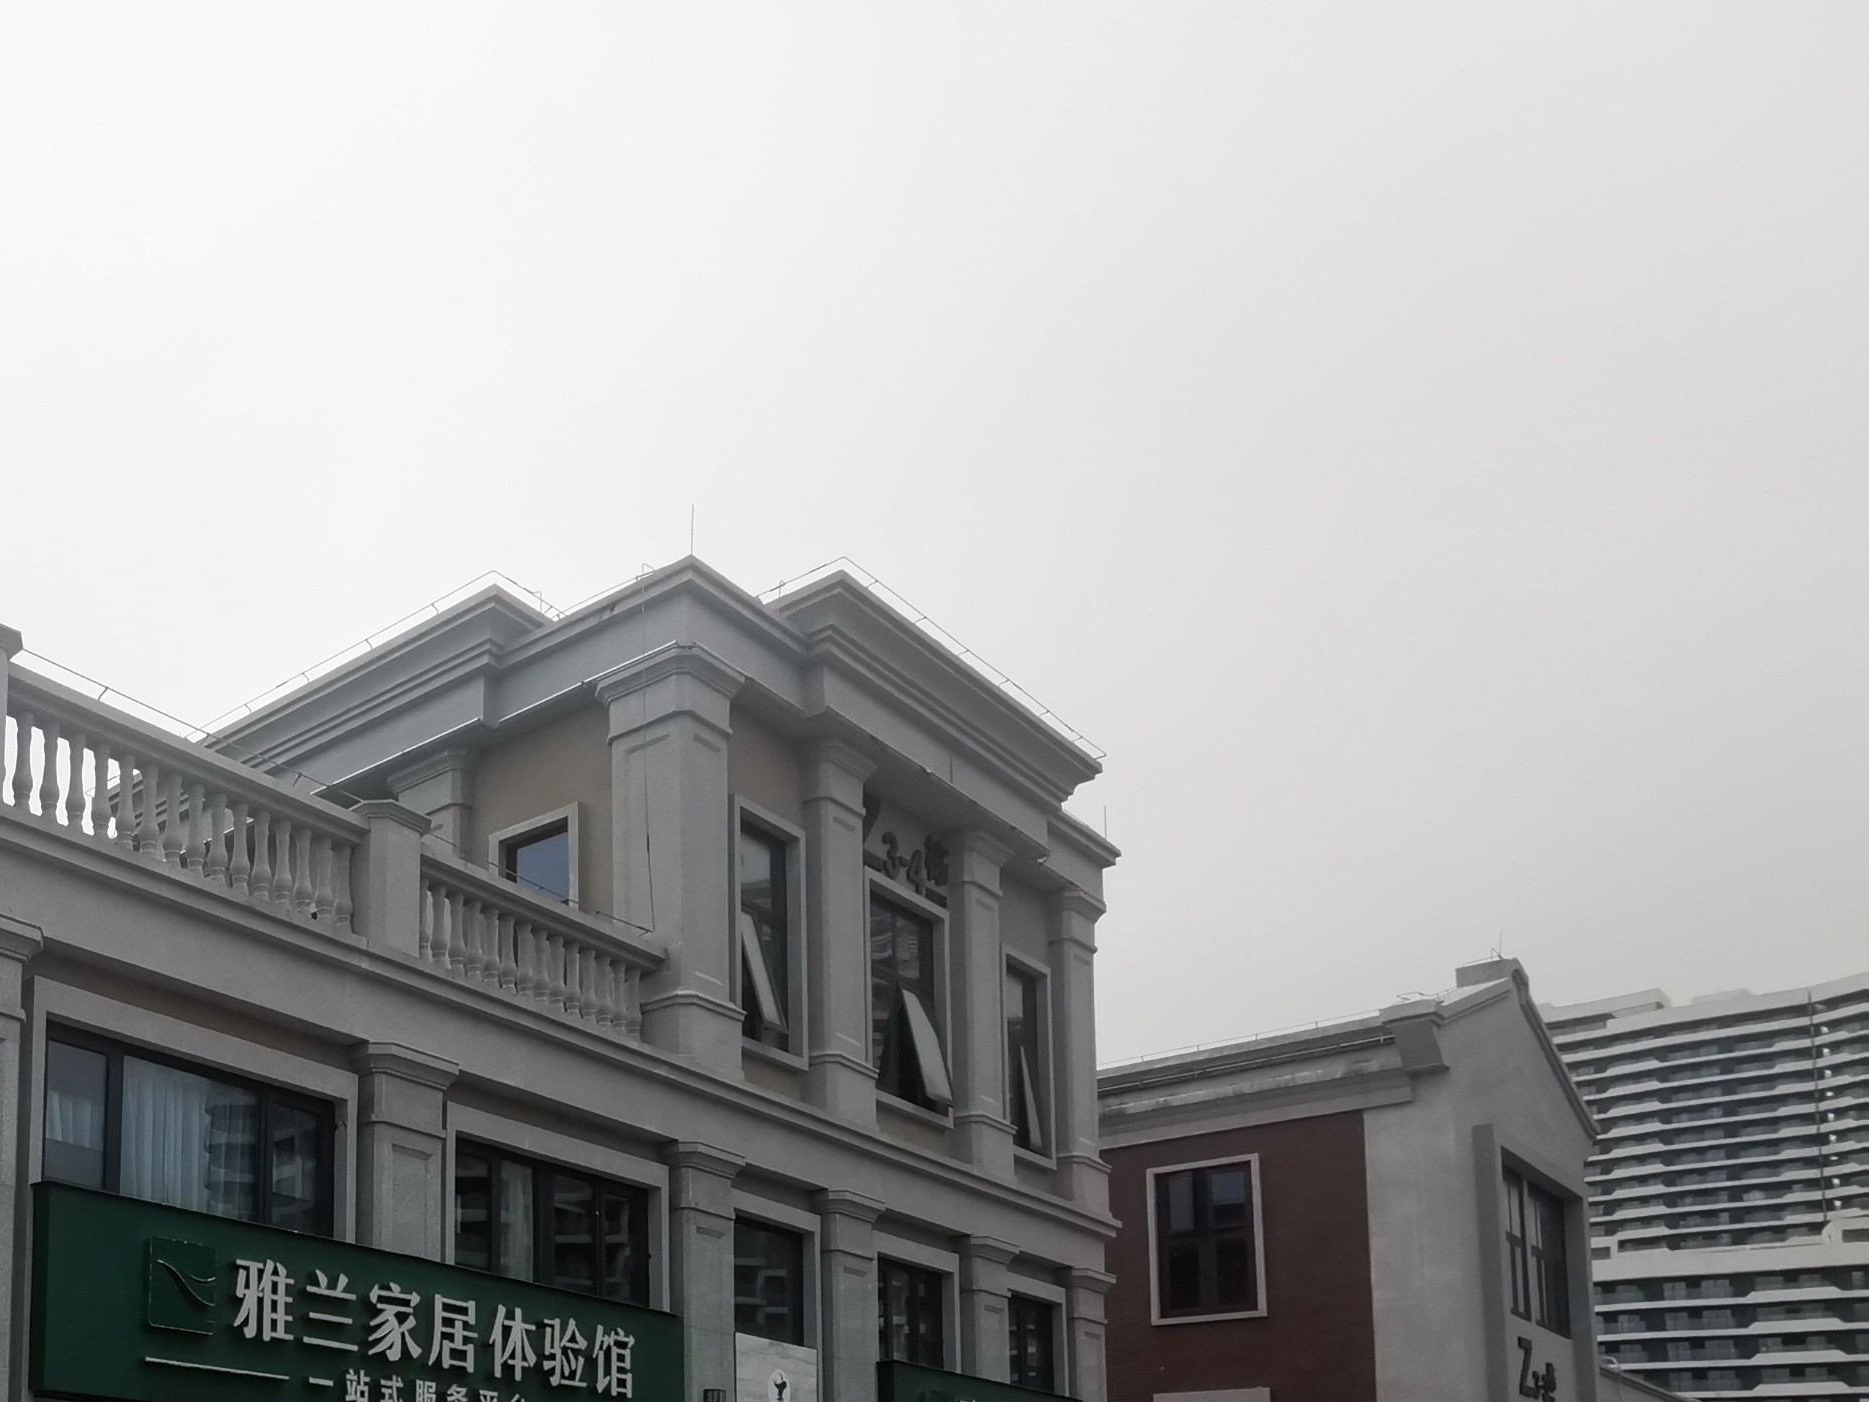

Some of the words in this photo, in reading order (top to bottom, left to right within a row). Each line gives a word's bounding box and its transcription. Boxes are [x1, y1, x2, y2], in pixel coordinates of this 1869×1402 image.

[233, 1259, 635, 1398] 雅兰家居体验馆
